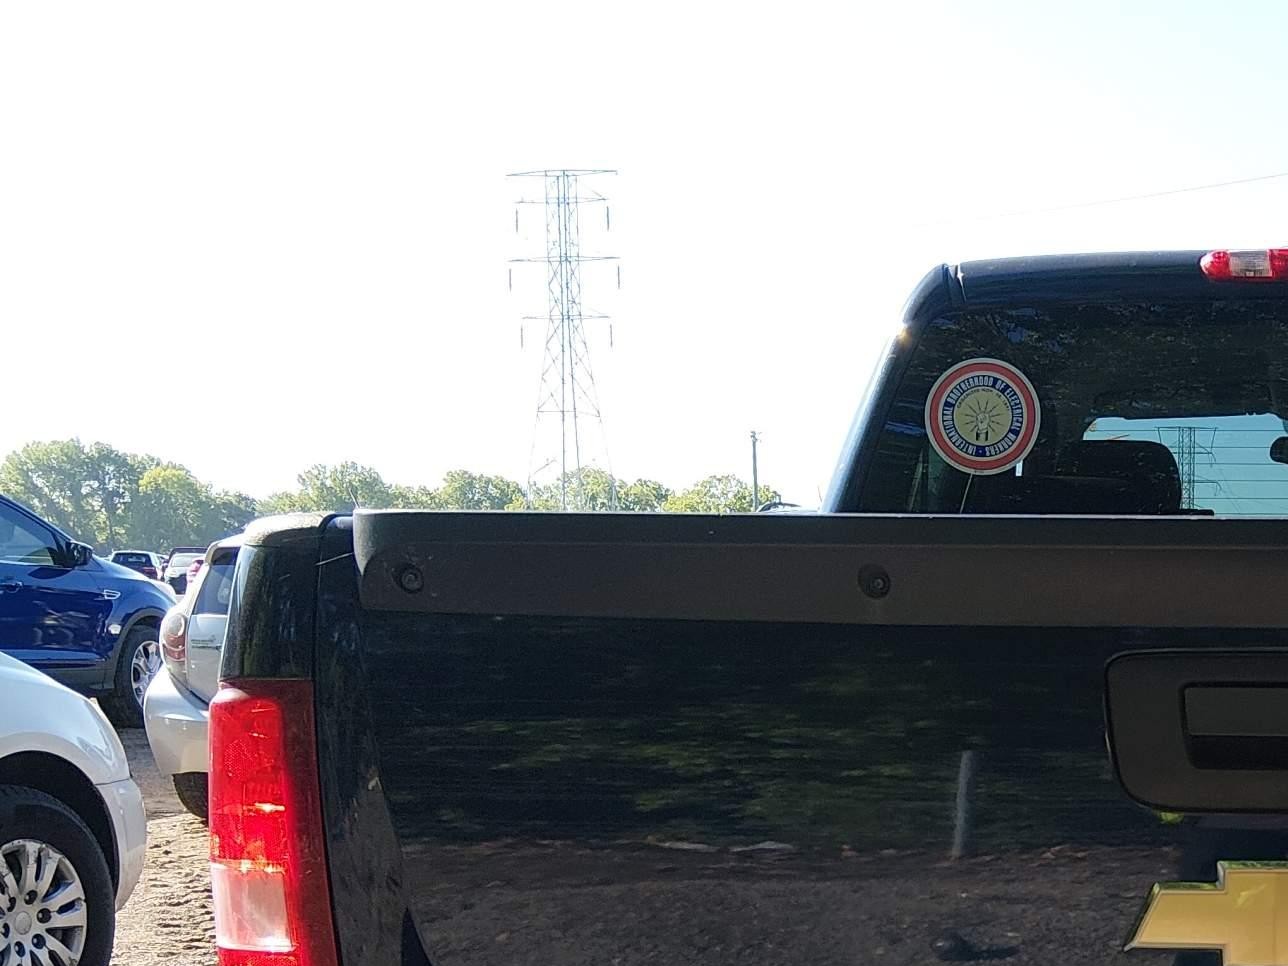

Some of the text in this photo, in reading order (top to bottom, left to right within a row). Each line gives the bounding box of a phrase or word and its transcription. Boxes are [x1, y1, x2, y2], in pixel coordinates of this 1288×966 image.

[948, 376, 994, 403] BROTHERHOOD
[995, 381, 1006, 391] OF
[1005, 387, 1023, 430] ELECTRICAL
[943, 407, 976, 456] INTERNATIONAL
[985, 433, 1017, 457] WORKERS
